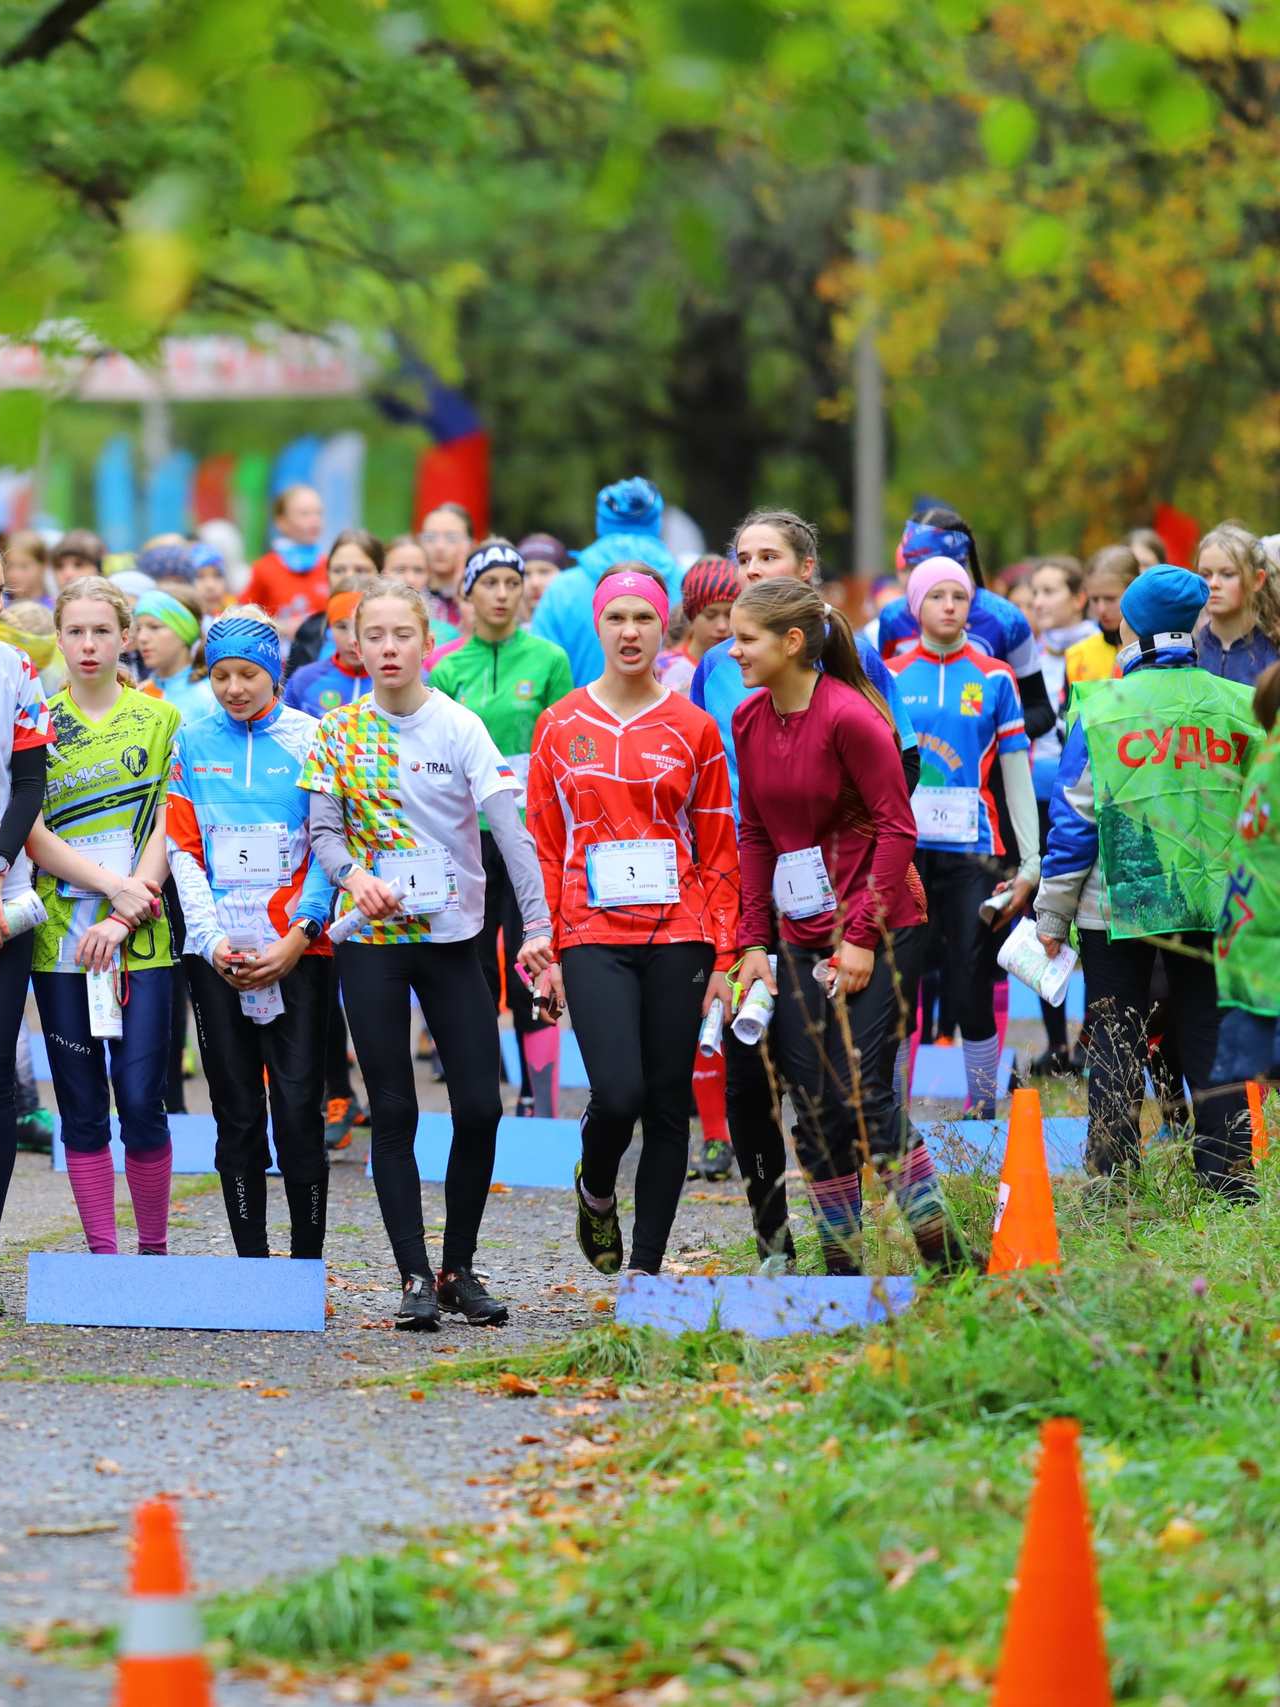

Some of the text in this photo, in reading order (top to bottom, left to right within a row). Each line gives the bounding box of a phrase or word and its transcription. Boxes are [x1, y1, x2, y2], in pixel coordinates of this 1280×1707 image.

[916, 732, 963, 772] ОРОНЕЖ
[641, 752, 686, 769] ORIENTEERING
[44, 759, 119, 800] ЕНИКС
[932, 808, 948, 821] 26
[239, 850, 248, 864] 5
[408, 874, 416, 888] 4
[626, 866, 635, 881] 3
[788, 881, 794, 894] 1
[50, 1033, 91, 1055] ARSWEAR
[311, 1185, 319, 1225] ARSWEAR
